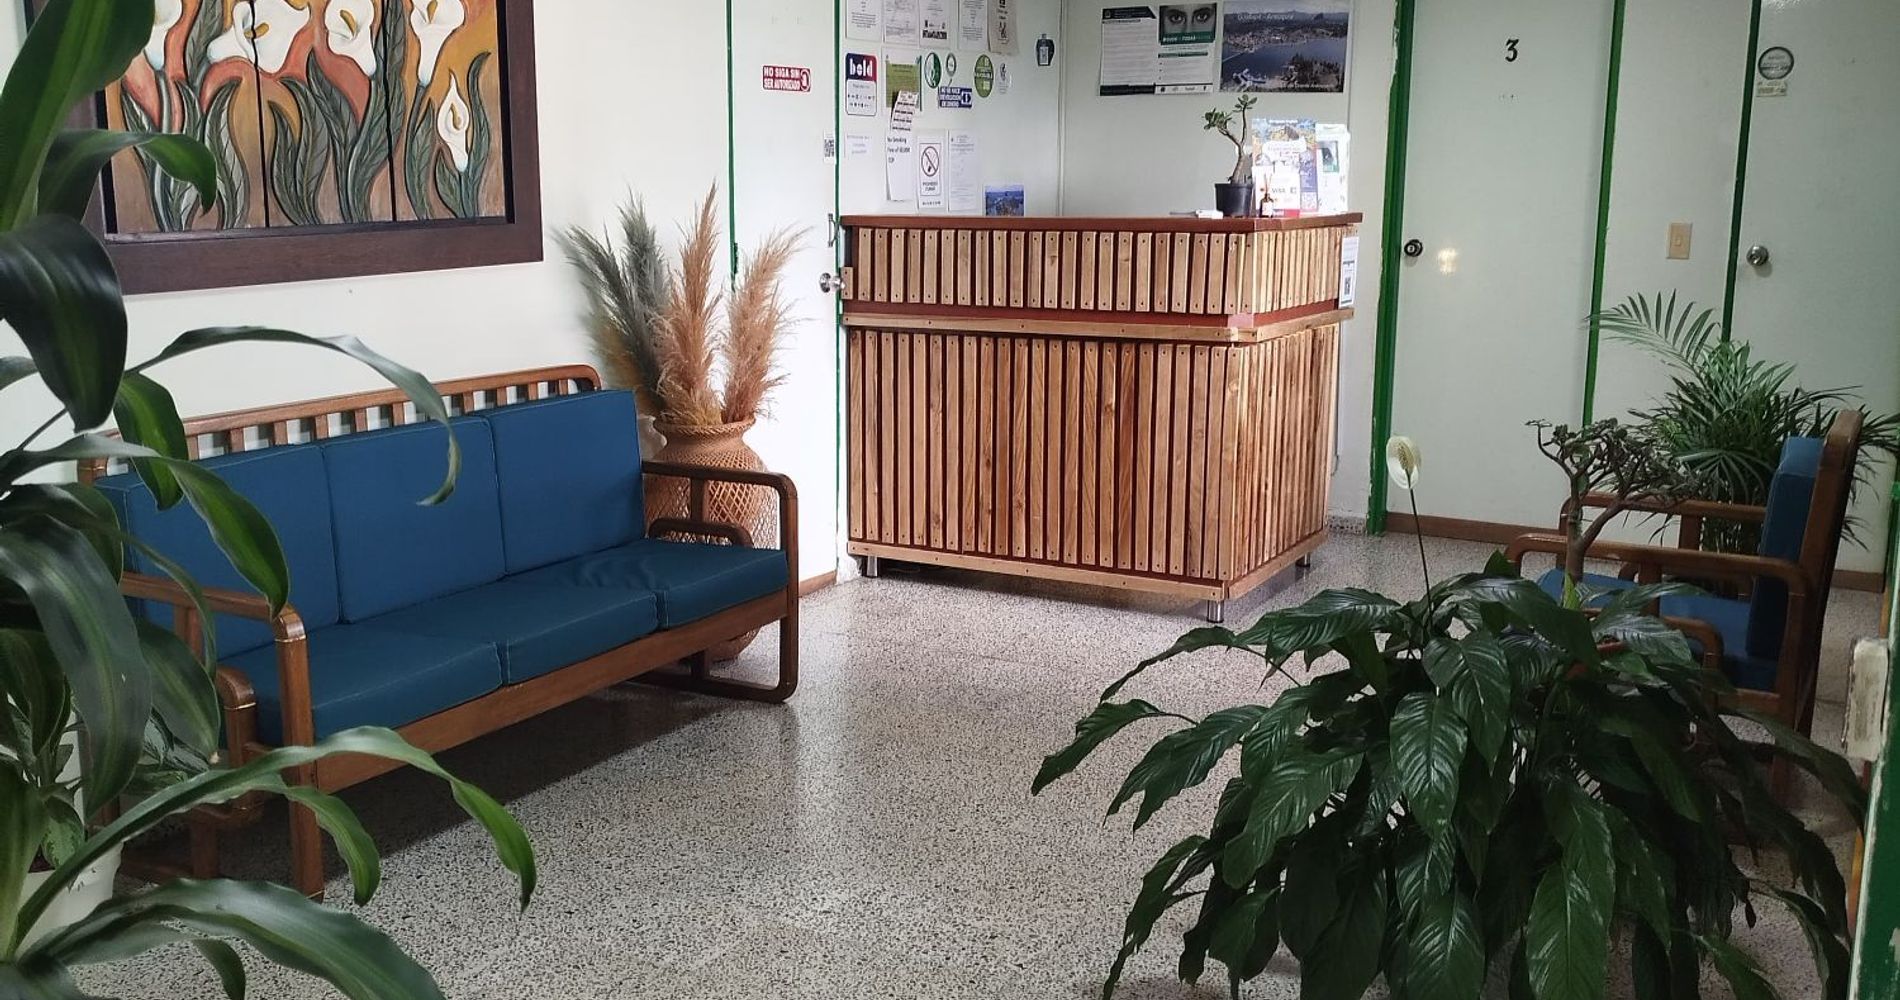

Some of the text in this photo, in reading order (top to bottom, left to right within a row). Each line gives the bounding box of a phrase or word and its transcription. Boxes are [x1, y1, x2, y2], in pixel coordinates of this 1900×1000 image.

[1505, 38, 1519, 62] 3
[764, 67, 801, 79] NO SIGA SIN
[850, 58, 872, 77] bold
[764, 78, 774, 88] SER
